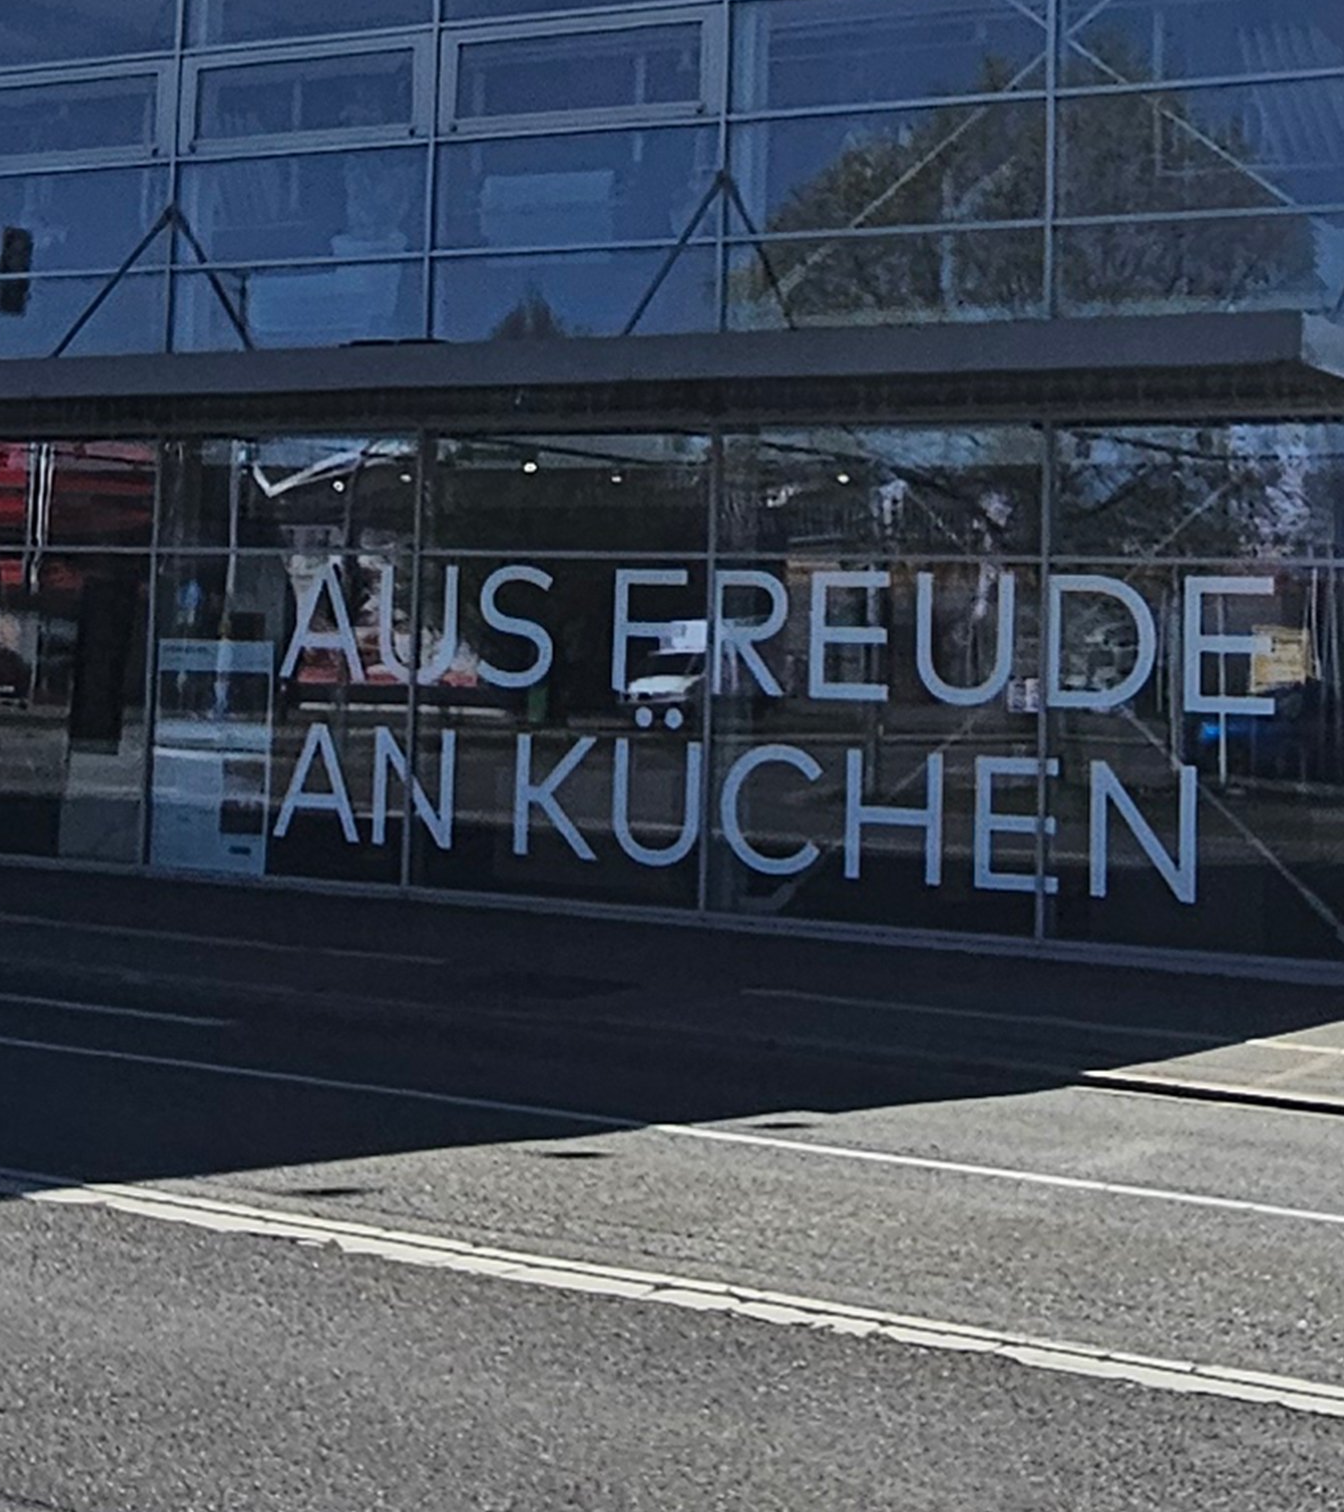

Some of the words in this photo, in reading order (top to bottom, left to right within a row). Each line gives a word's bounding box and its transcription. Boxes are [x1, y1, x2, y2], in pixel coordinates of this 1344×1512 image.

[279, 564, 554, 688] AUS
[611, 568, 1276, 716] FREUDE
[272, 723, 455, 850] AN
[513, 706, 1197, 904] KÜCHEN
